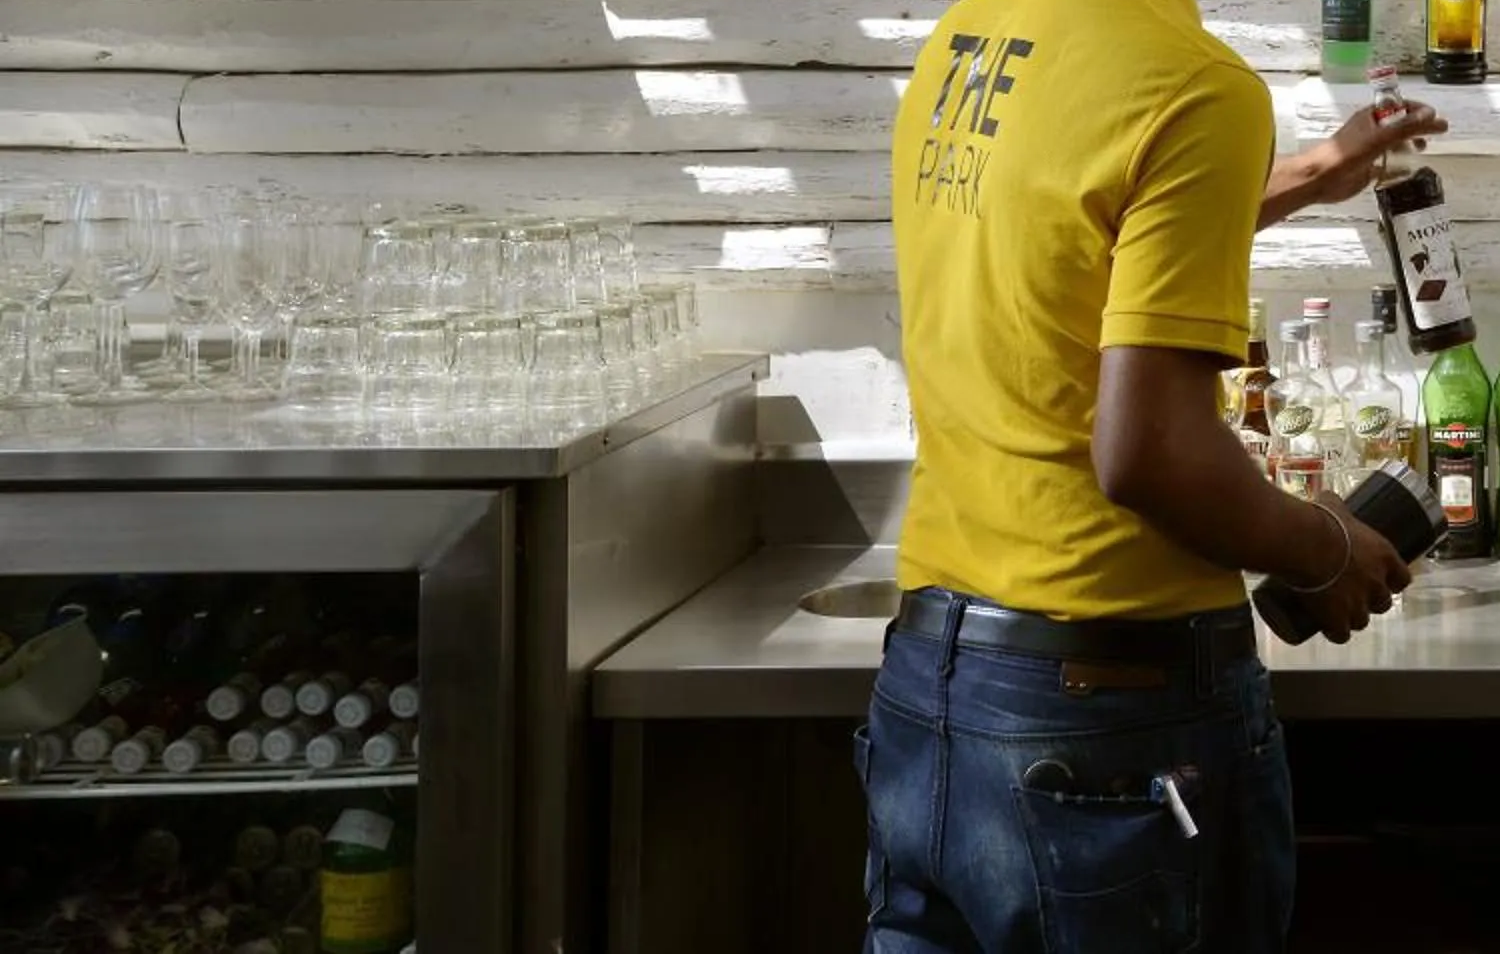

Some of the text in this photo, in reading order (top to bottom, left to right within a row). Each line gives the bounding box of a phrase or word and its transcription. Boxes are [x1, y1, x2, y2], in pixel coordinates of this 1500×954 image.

[932, 34, 1035, 138] THE
[916, 138, 991, 220] PARK
[1433, 430, 1480, 440] MARTINI
